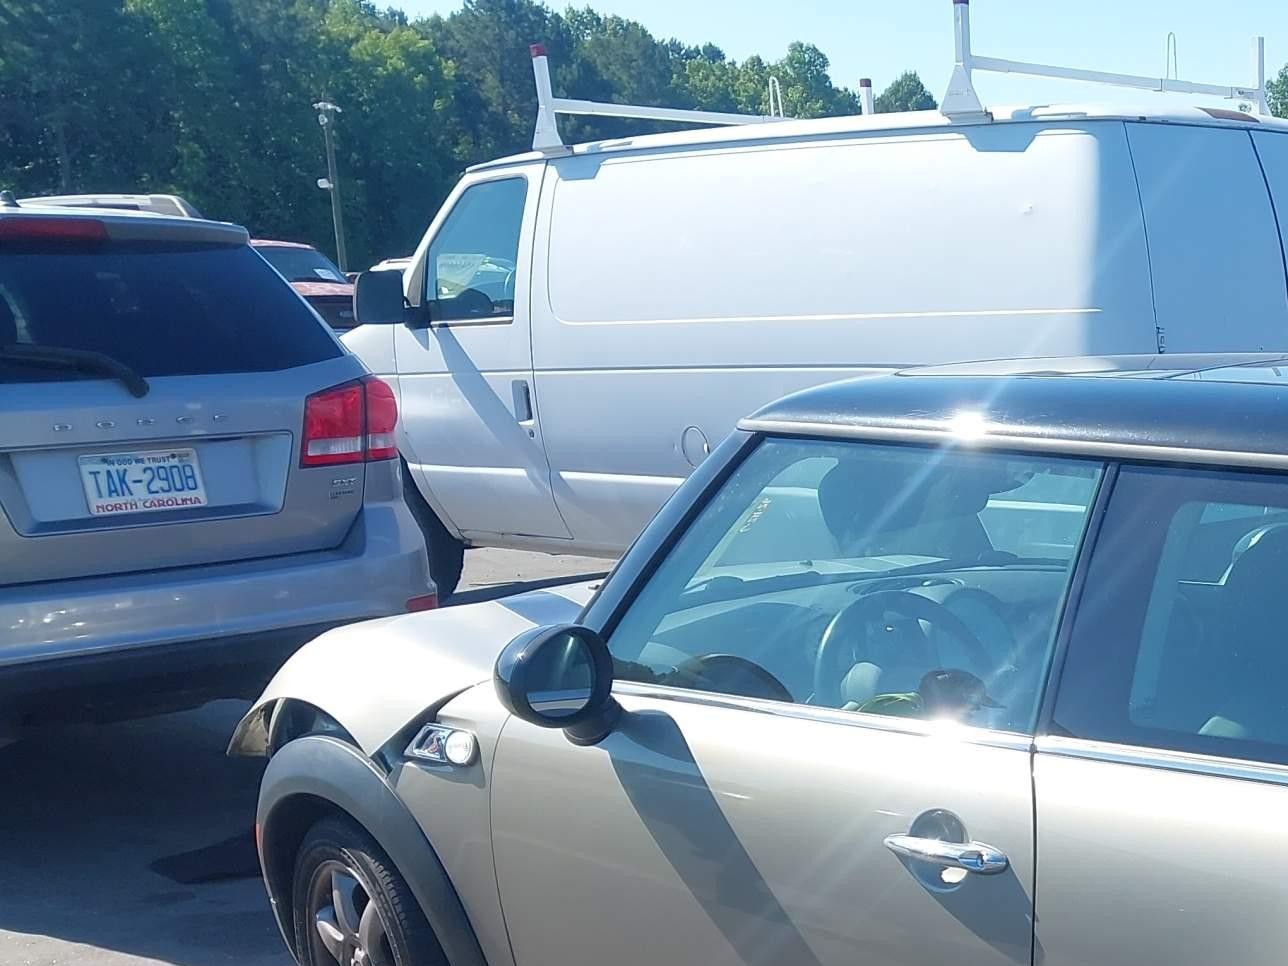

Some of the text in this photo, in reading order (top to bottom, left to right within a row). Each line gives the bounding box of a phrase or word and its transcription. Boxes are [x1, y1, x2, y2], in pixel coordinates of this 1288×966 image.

[147, 455, 170, 465] TRUST
[88, 464, 198, 499] TAK-2908
[95, 496, 202, 514] NORTH CAROLINA
